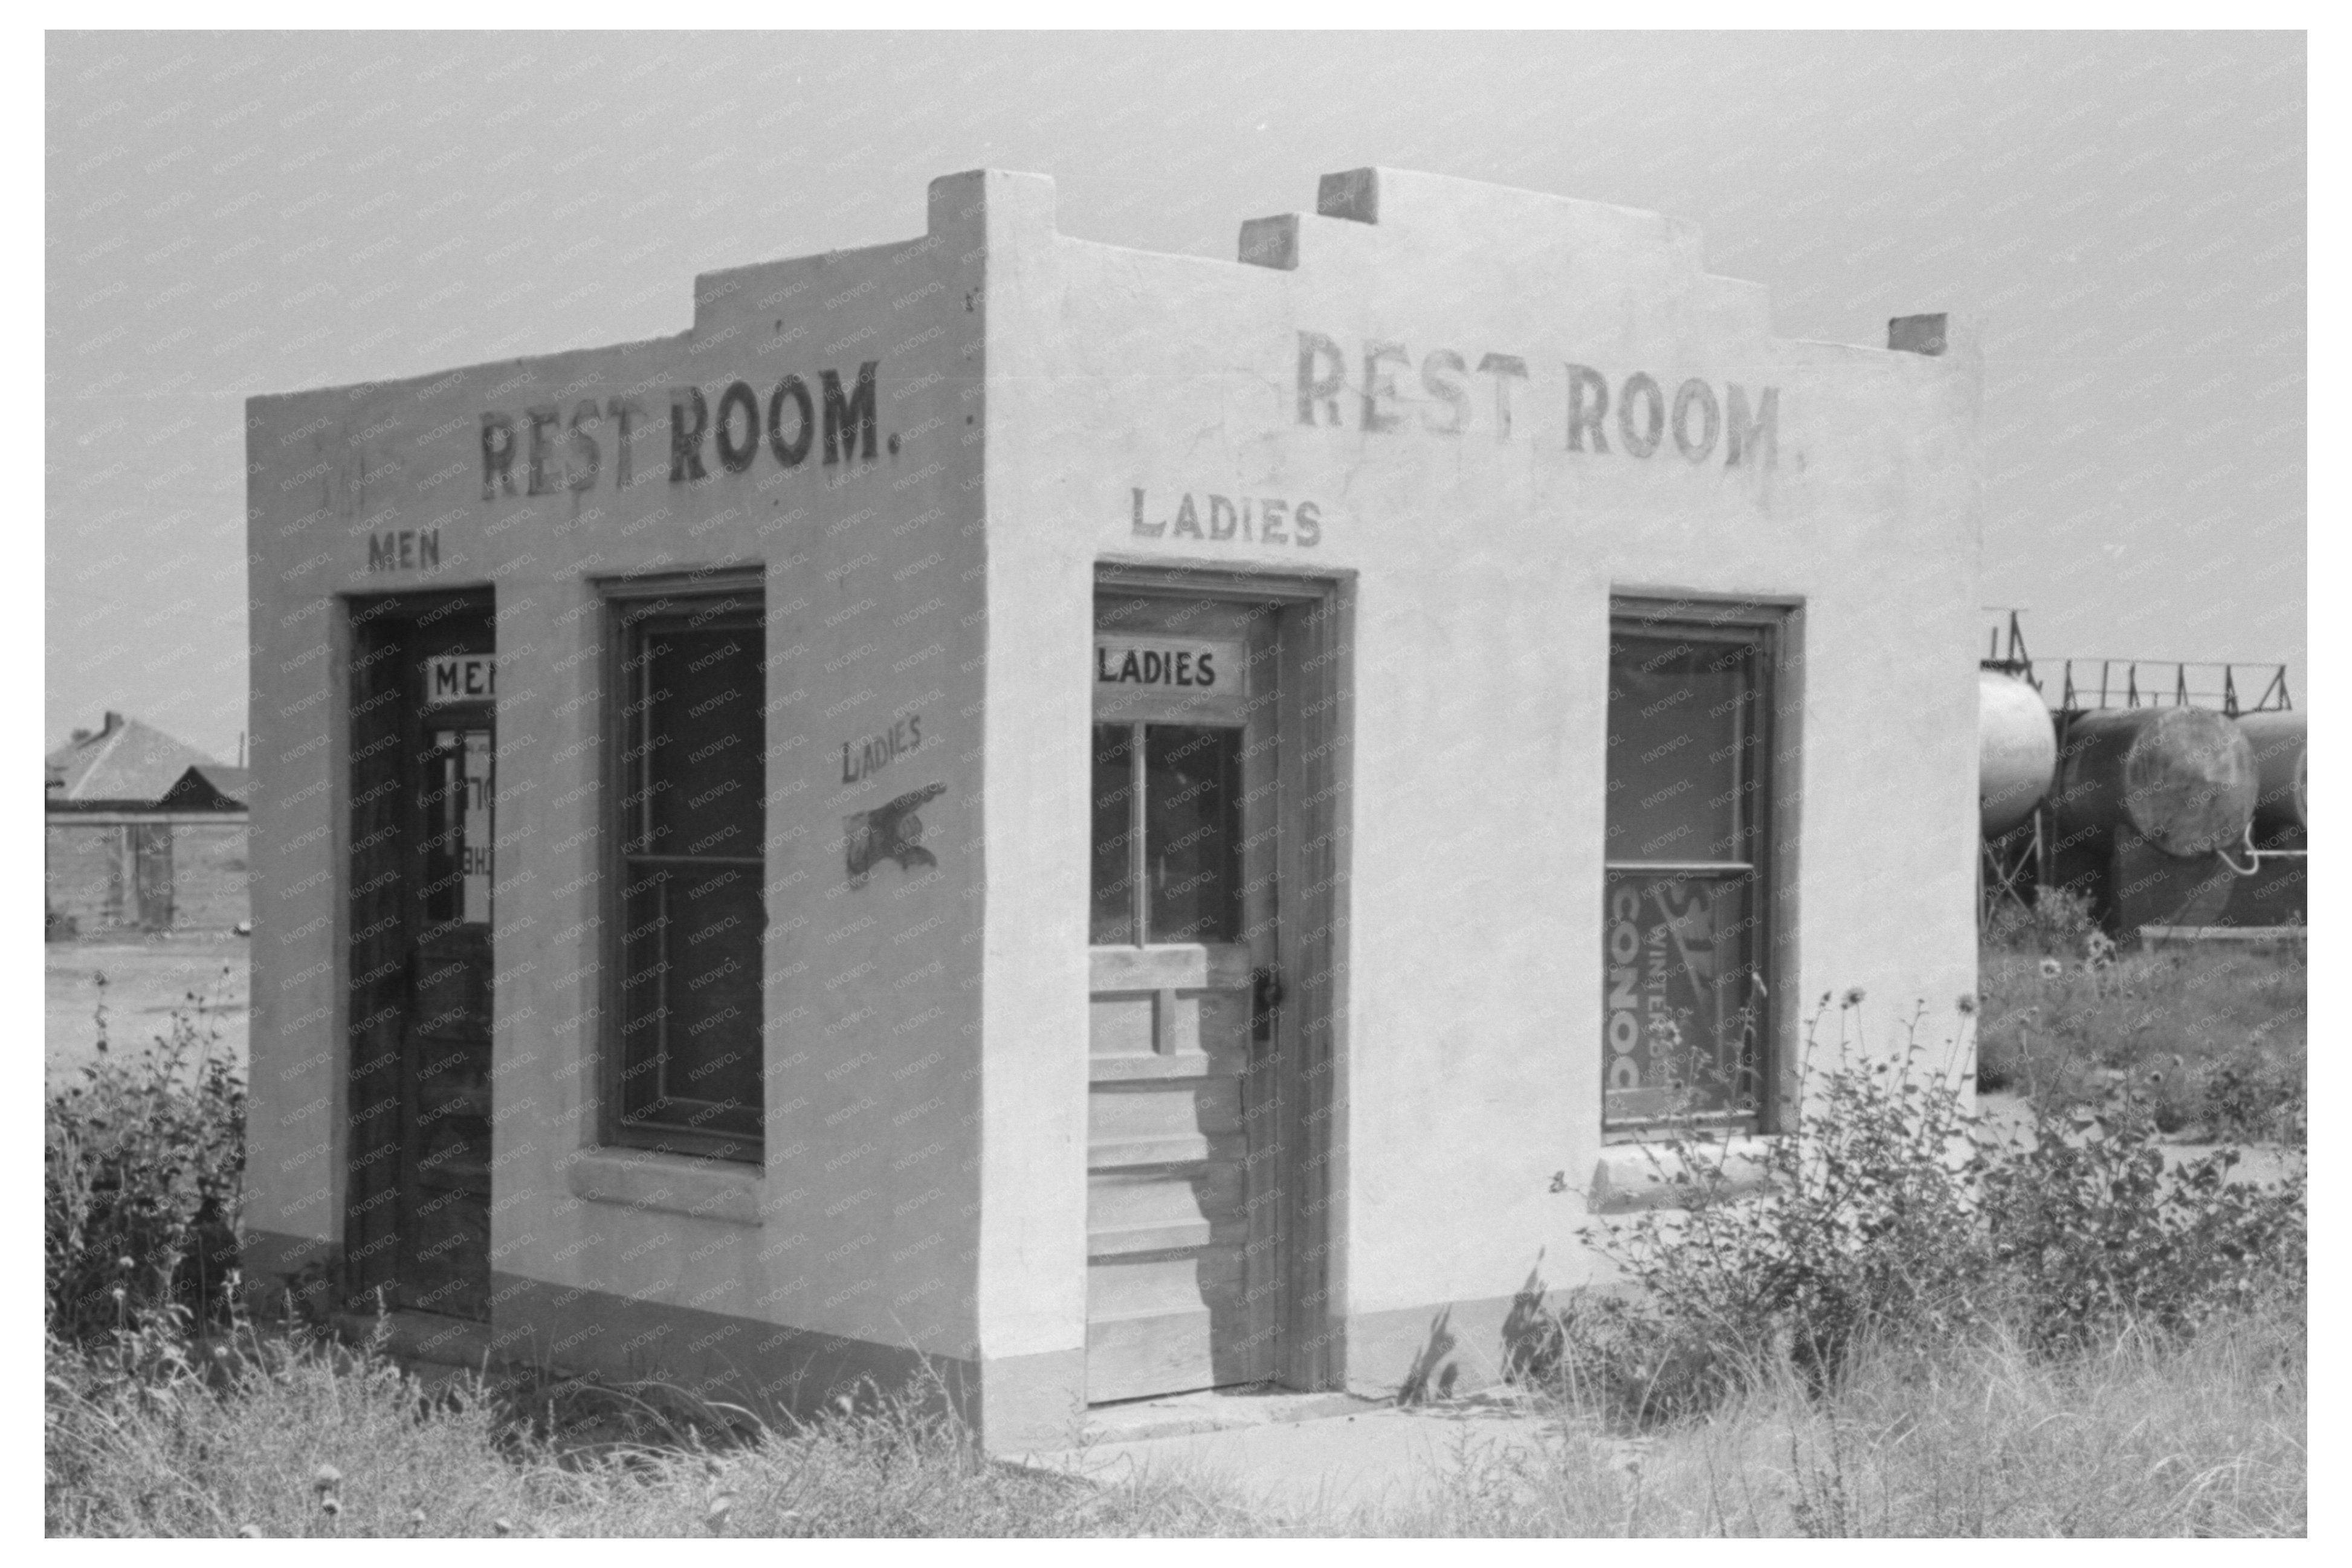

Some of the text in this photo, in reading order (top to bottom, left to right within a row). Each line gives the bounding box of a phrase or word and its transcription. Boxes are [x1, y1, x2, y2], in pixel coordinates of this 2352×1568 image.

[1295, 330, 1529, 444] REST
[479, 396, 648, 501] REST
[1131, 487, 1322, 547] LADIES
[368, 528, 440, 573] MEN
[1097, 647, 1216, 686] LADIES
[841, 714, 922, 784] LADIES
